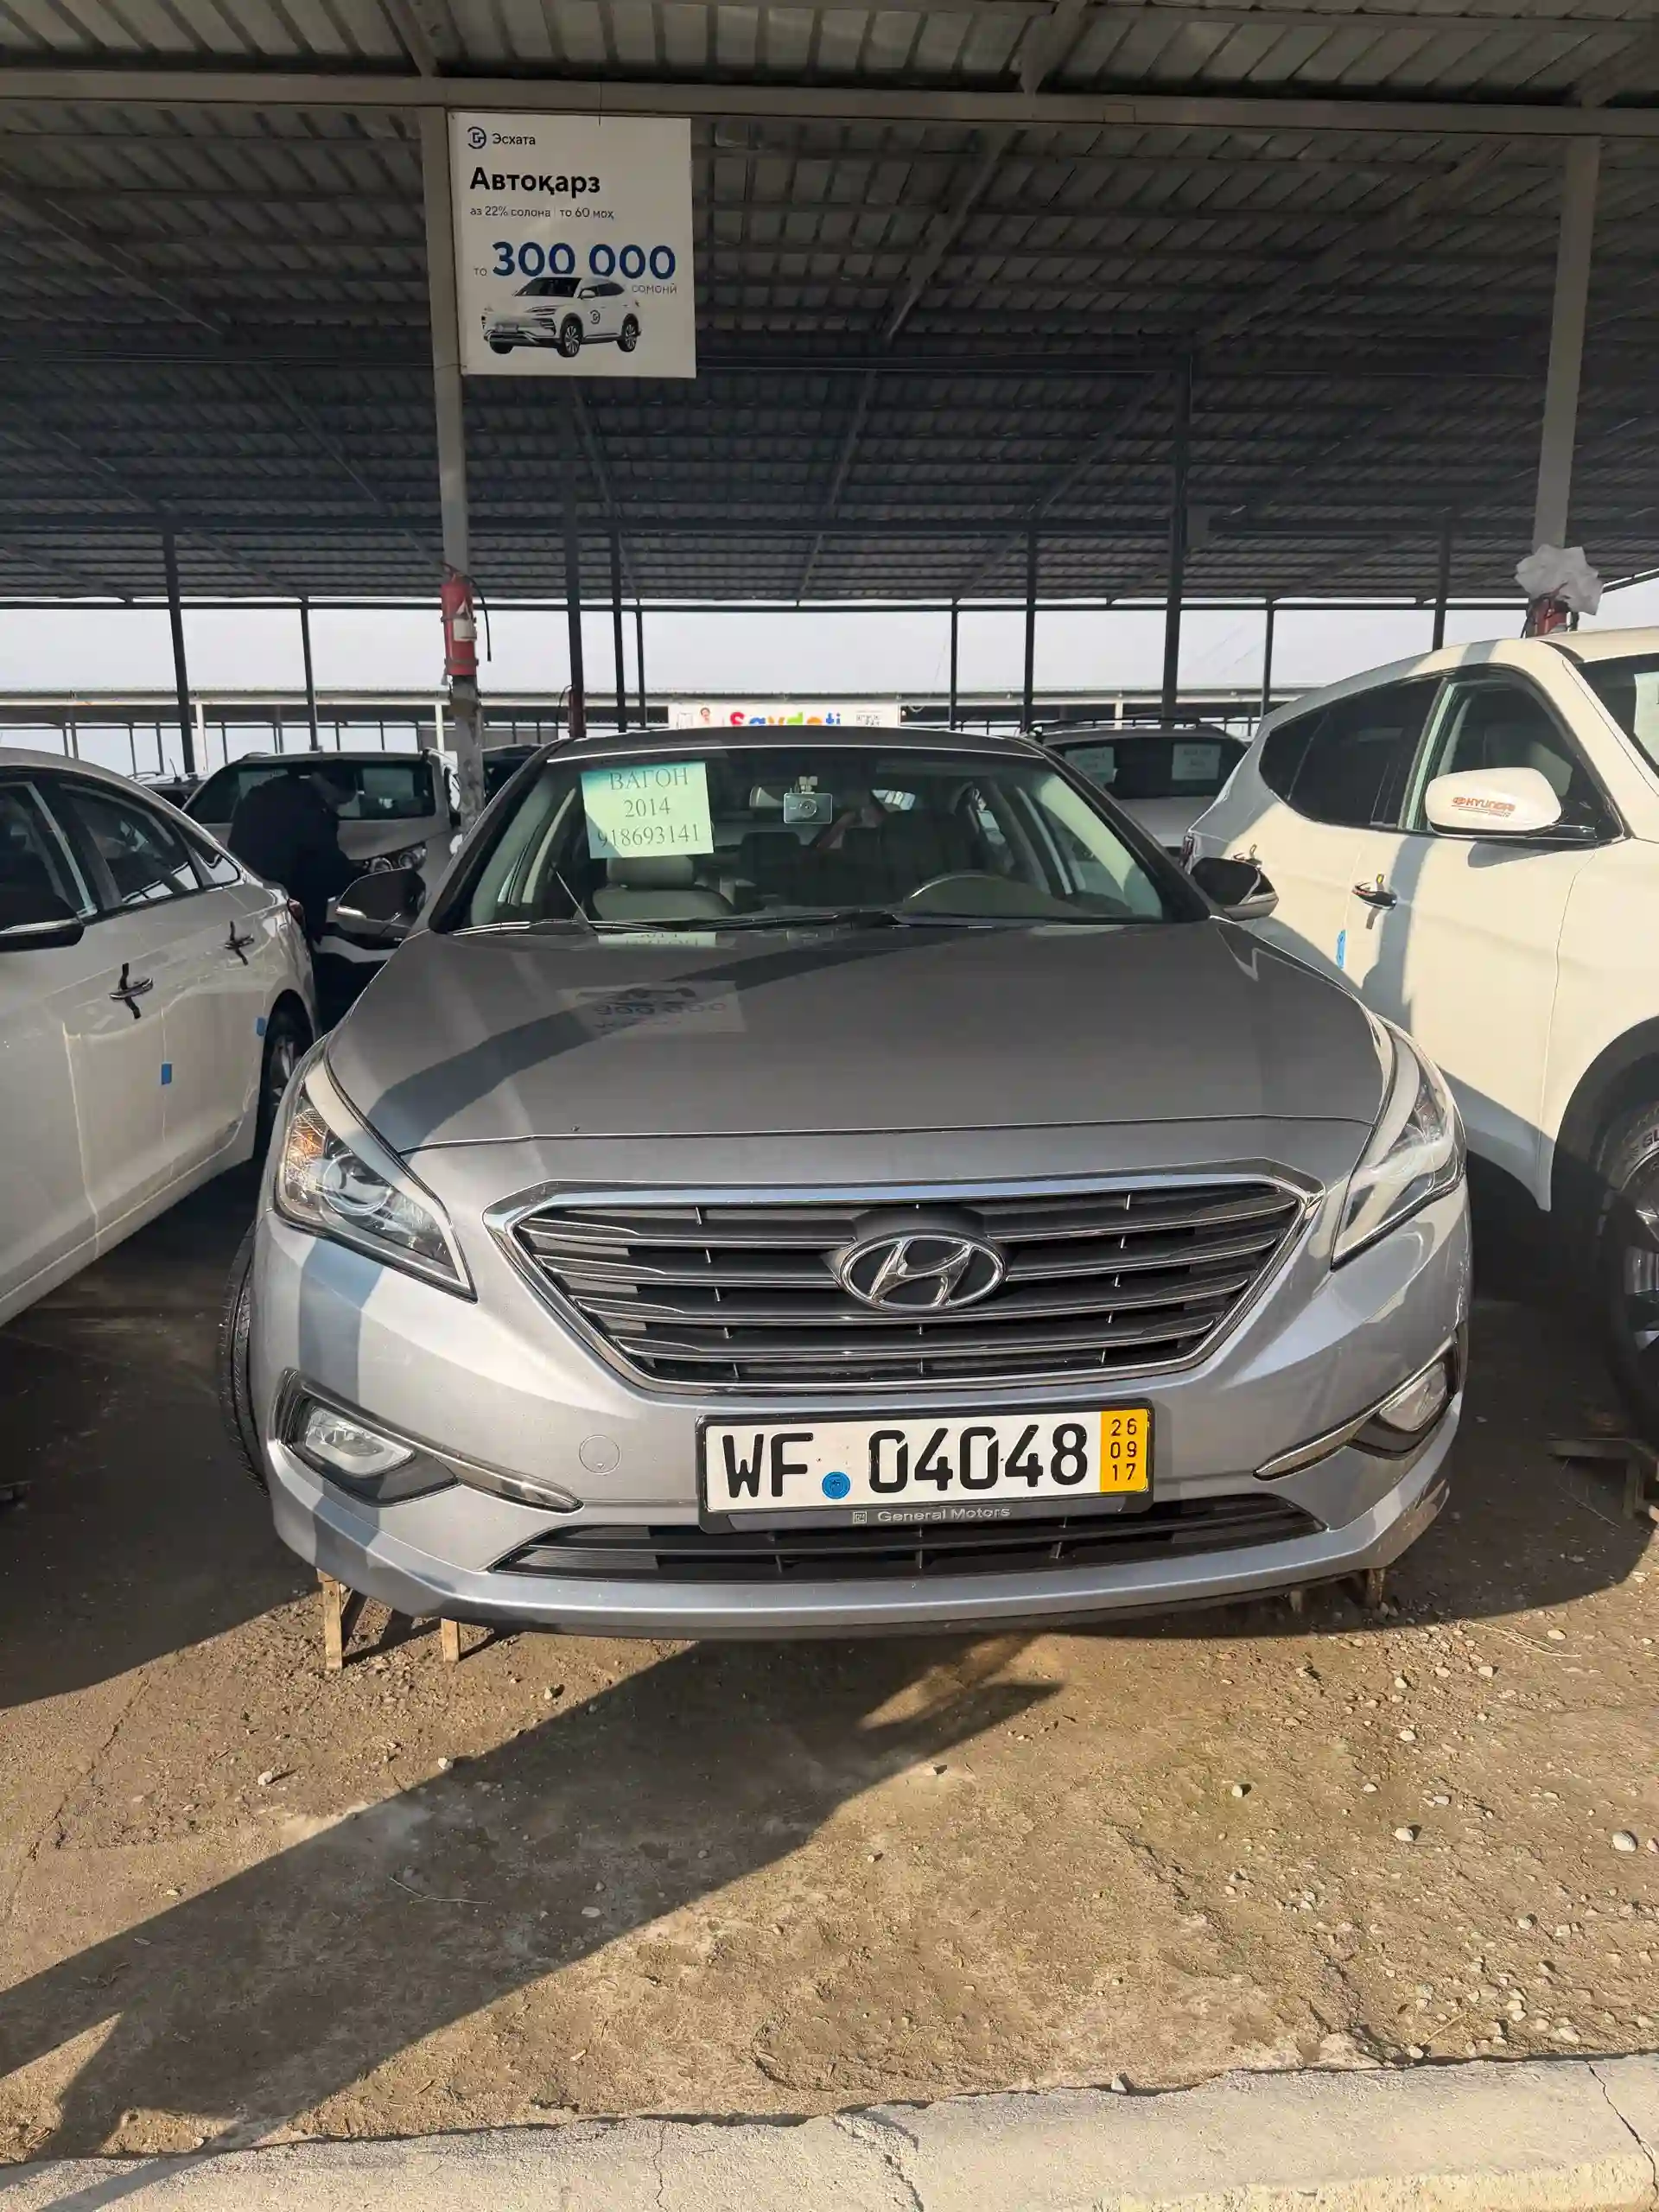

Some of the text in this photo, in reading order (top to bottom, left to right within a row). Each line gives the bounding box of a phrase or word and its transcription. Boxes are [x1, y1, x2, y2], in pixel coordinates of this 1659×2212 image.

[492, 132, 537, 146] Эсхата
[469, 166, 601, 199] Автоқарз
[469, 207, 483, 216] аз
[485, 206, 508, 217] 22%
[511, 208, 551, 218] солона
[559, 208, 572, 218] то
[575, 207, 590, 218] 60
[474, 241, 677, 279] то 300 000
[609, 766, 689, 791] ВАГОН
[623, 797, 671, 818] 2014
[597, 823, 701, 848] 918693141
[1110, 1418, 1137, 1436] 26
[1110, 1441, 1137, 1459] 09
[721, 1422, 1089, 1498] WF 04048
[1112, 1463, 1136, 1481] 17
[877, 1510, 946, 1522] General
[951, 1507, 1011, 1520] Motors
